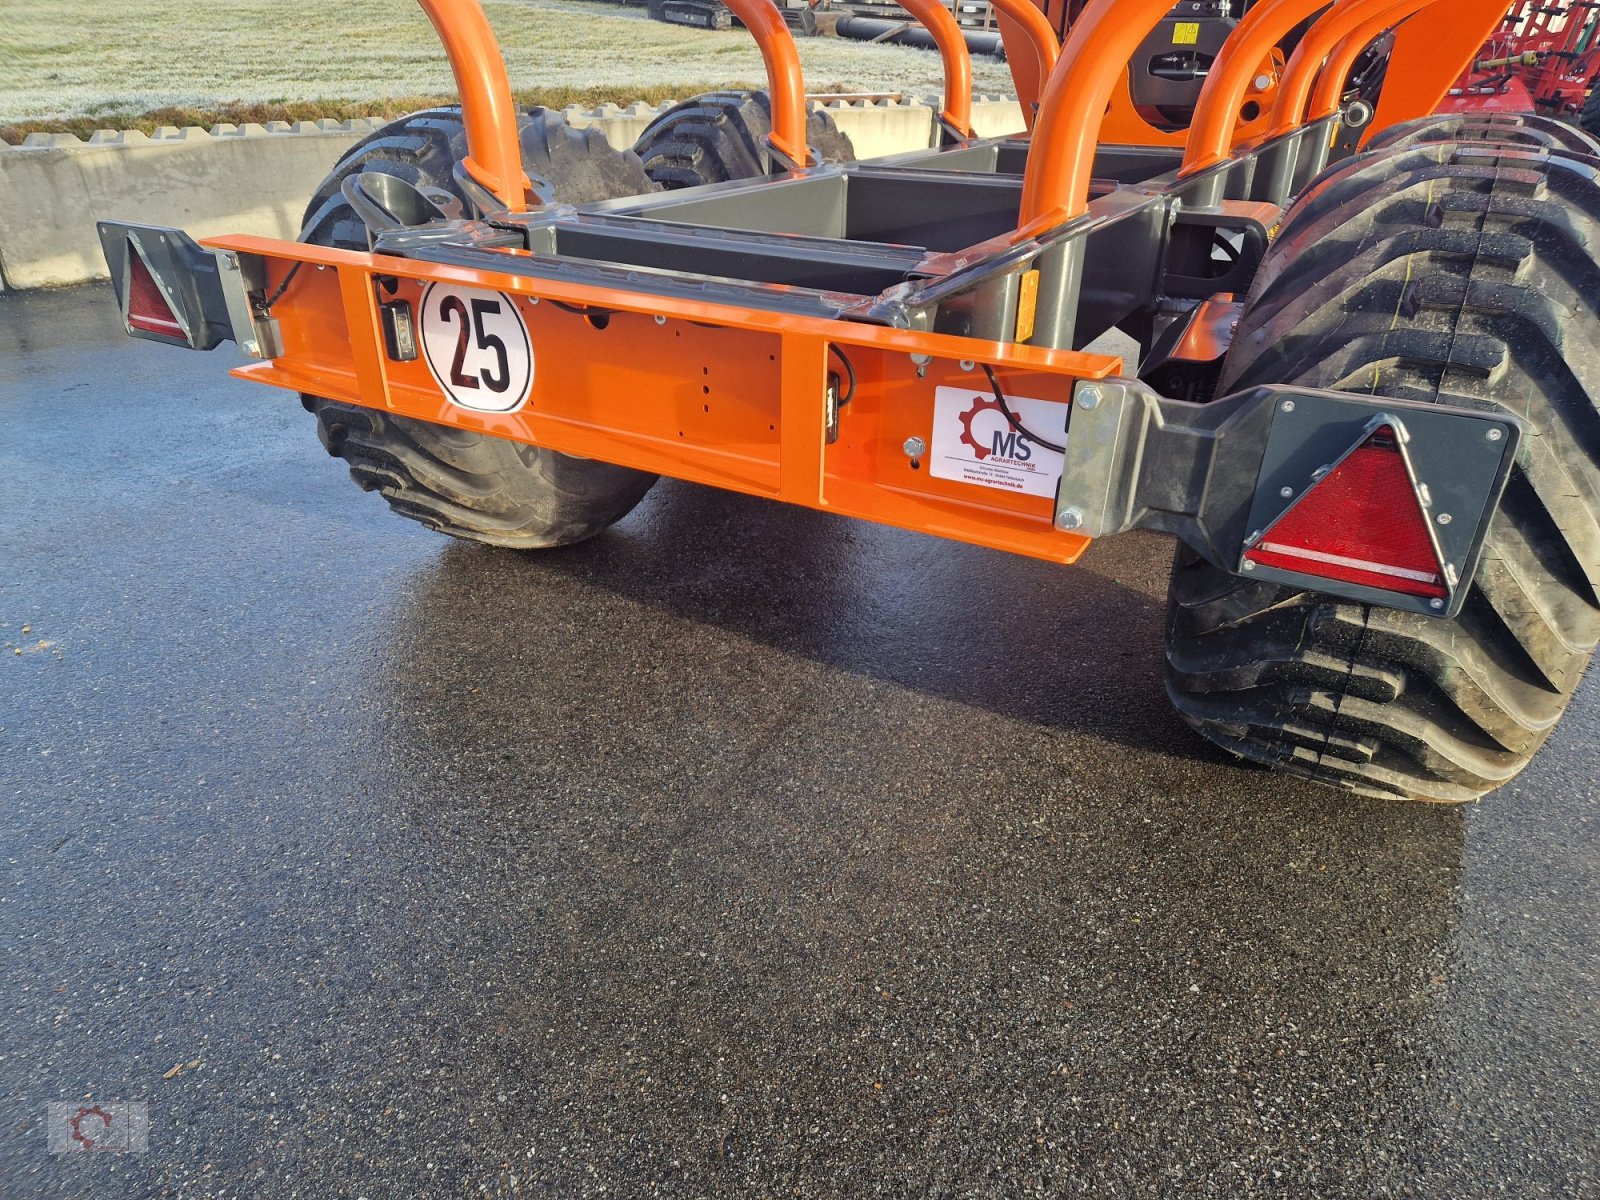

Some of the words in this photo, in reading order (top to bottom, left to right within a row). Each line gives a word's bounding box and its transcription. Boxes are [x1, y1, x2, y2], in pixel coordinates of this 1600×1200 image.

[439, 295, 510, 393] 25
[991, 430, 1032, 461] MS
[990, 456, 1036, 469] AGRARTECHNIK
[963, 474, 1024, 489] www.ms-agrartechnik.de
